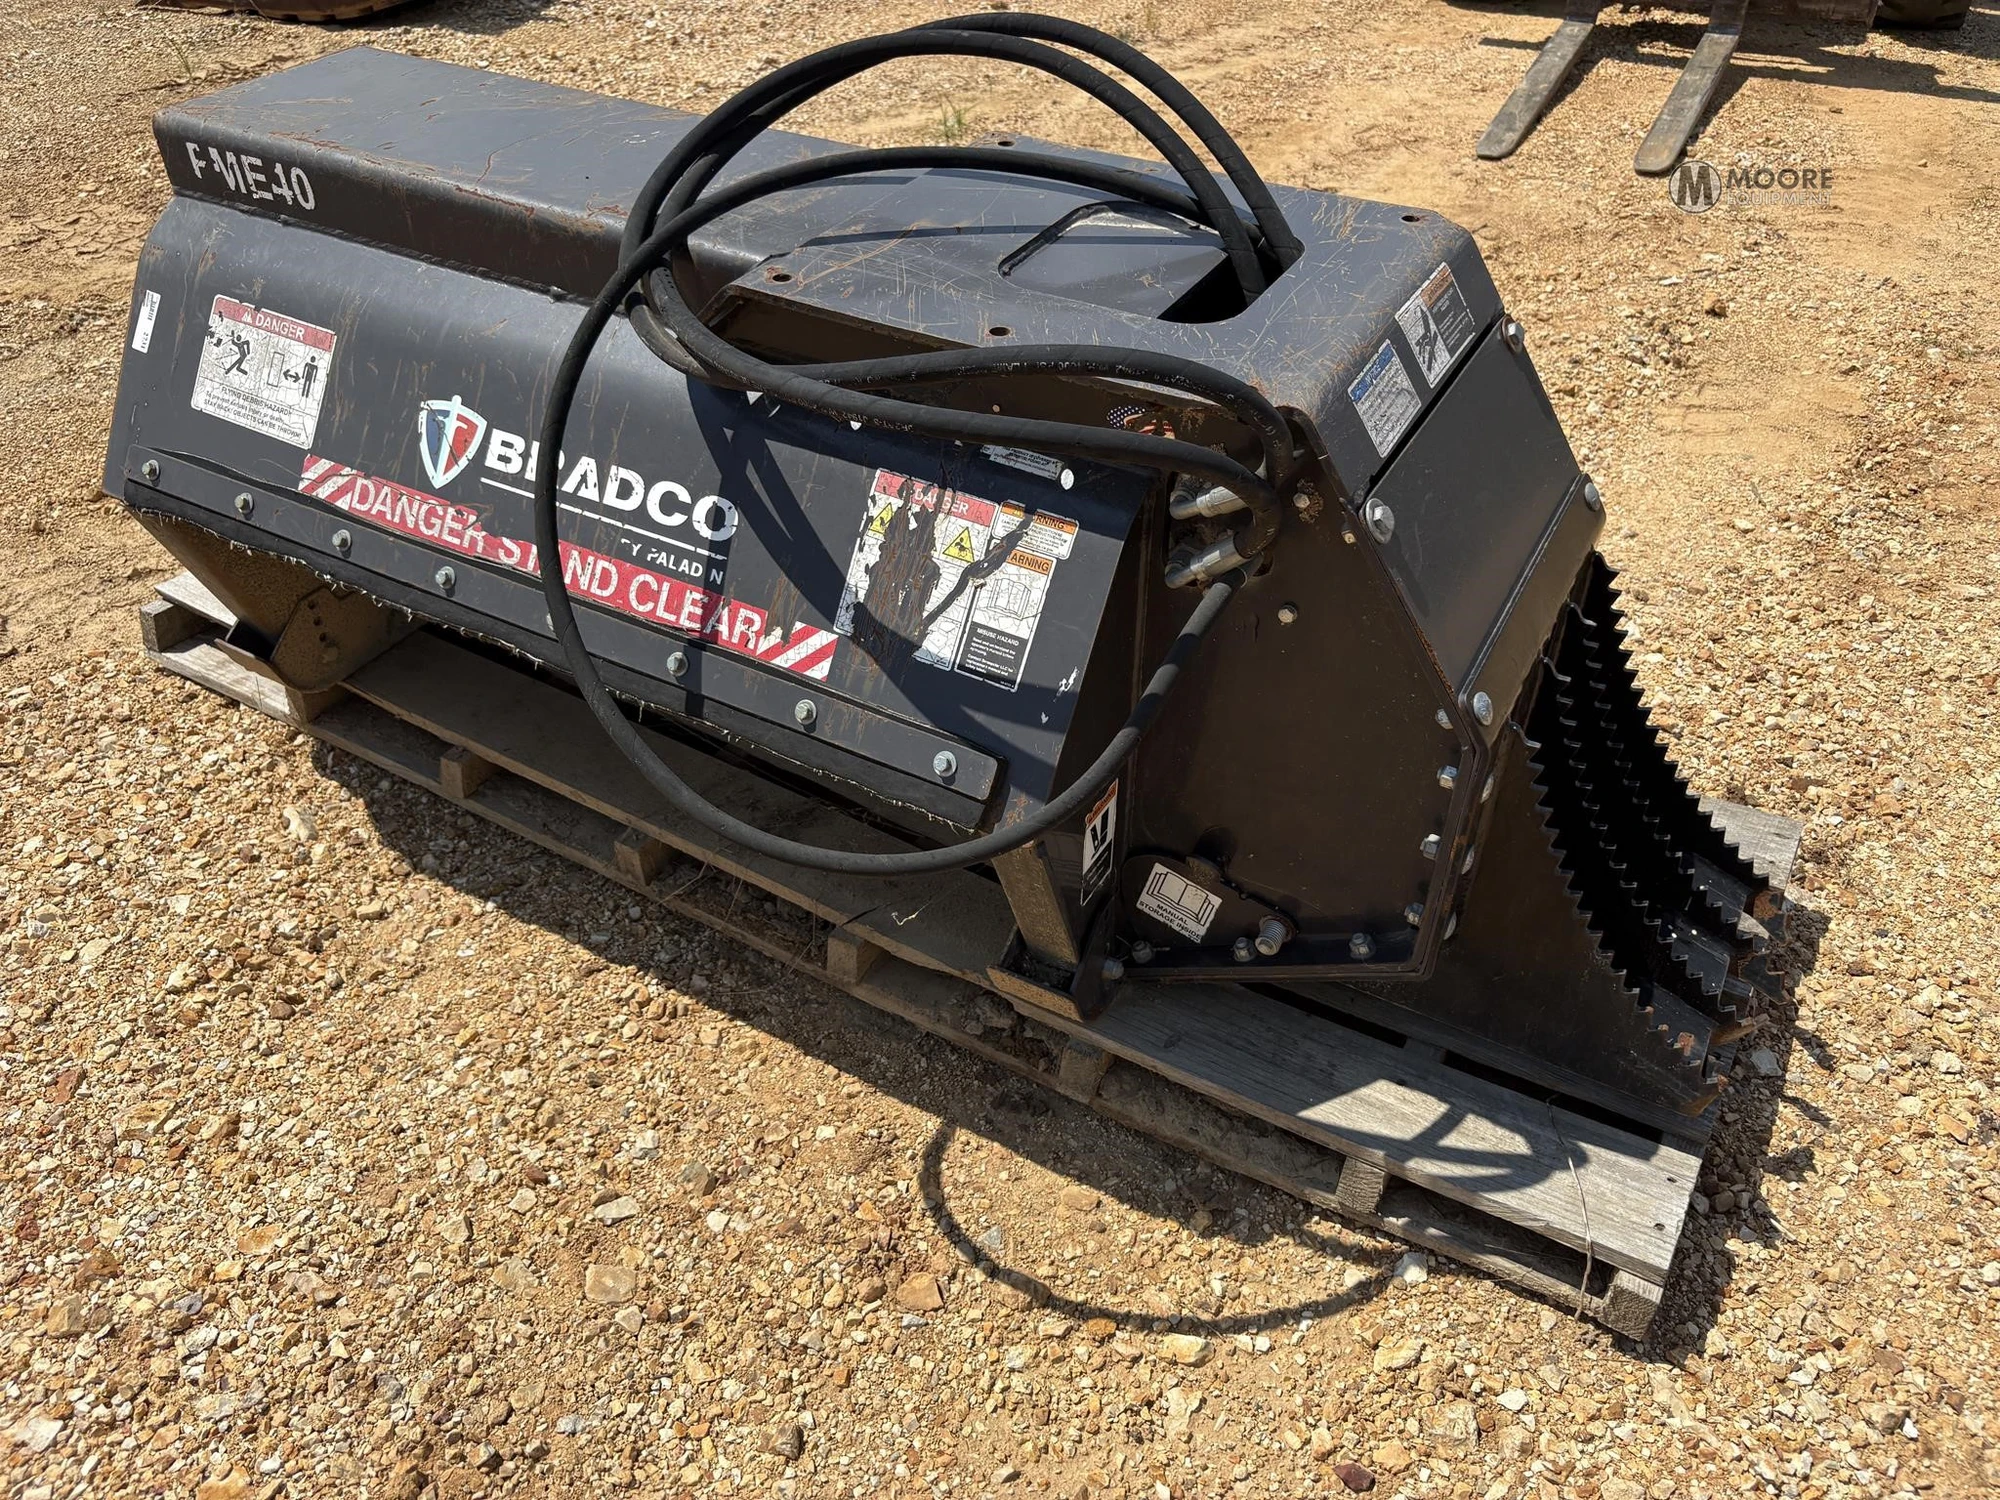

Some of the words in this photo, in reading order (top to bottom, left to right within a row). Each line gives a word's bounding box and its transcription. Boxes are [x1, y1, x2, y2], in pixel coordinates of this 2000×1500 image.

[255, 312, 306, 342] DANGER
[241, 393, 264, 408] DEBRIS
[350, 476, 487, 554] DANGER
[646, 547, 724, 586] PALADN
[1009, 551, 1050, 573] ARNING
[498, 537, 619, 598] STND
[628, 574, 763, 650] CLEAR
[1138, 899, 1176, 927] STORAGE
[1175, 921, 1201, 940] INSIDE
[1156, 903, 1189, 926] MANUAL
